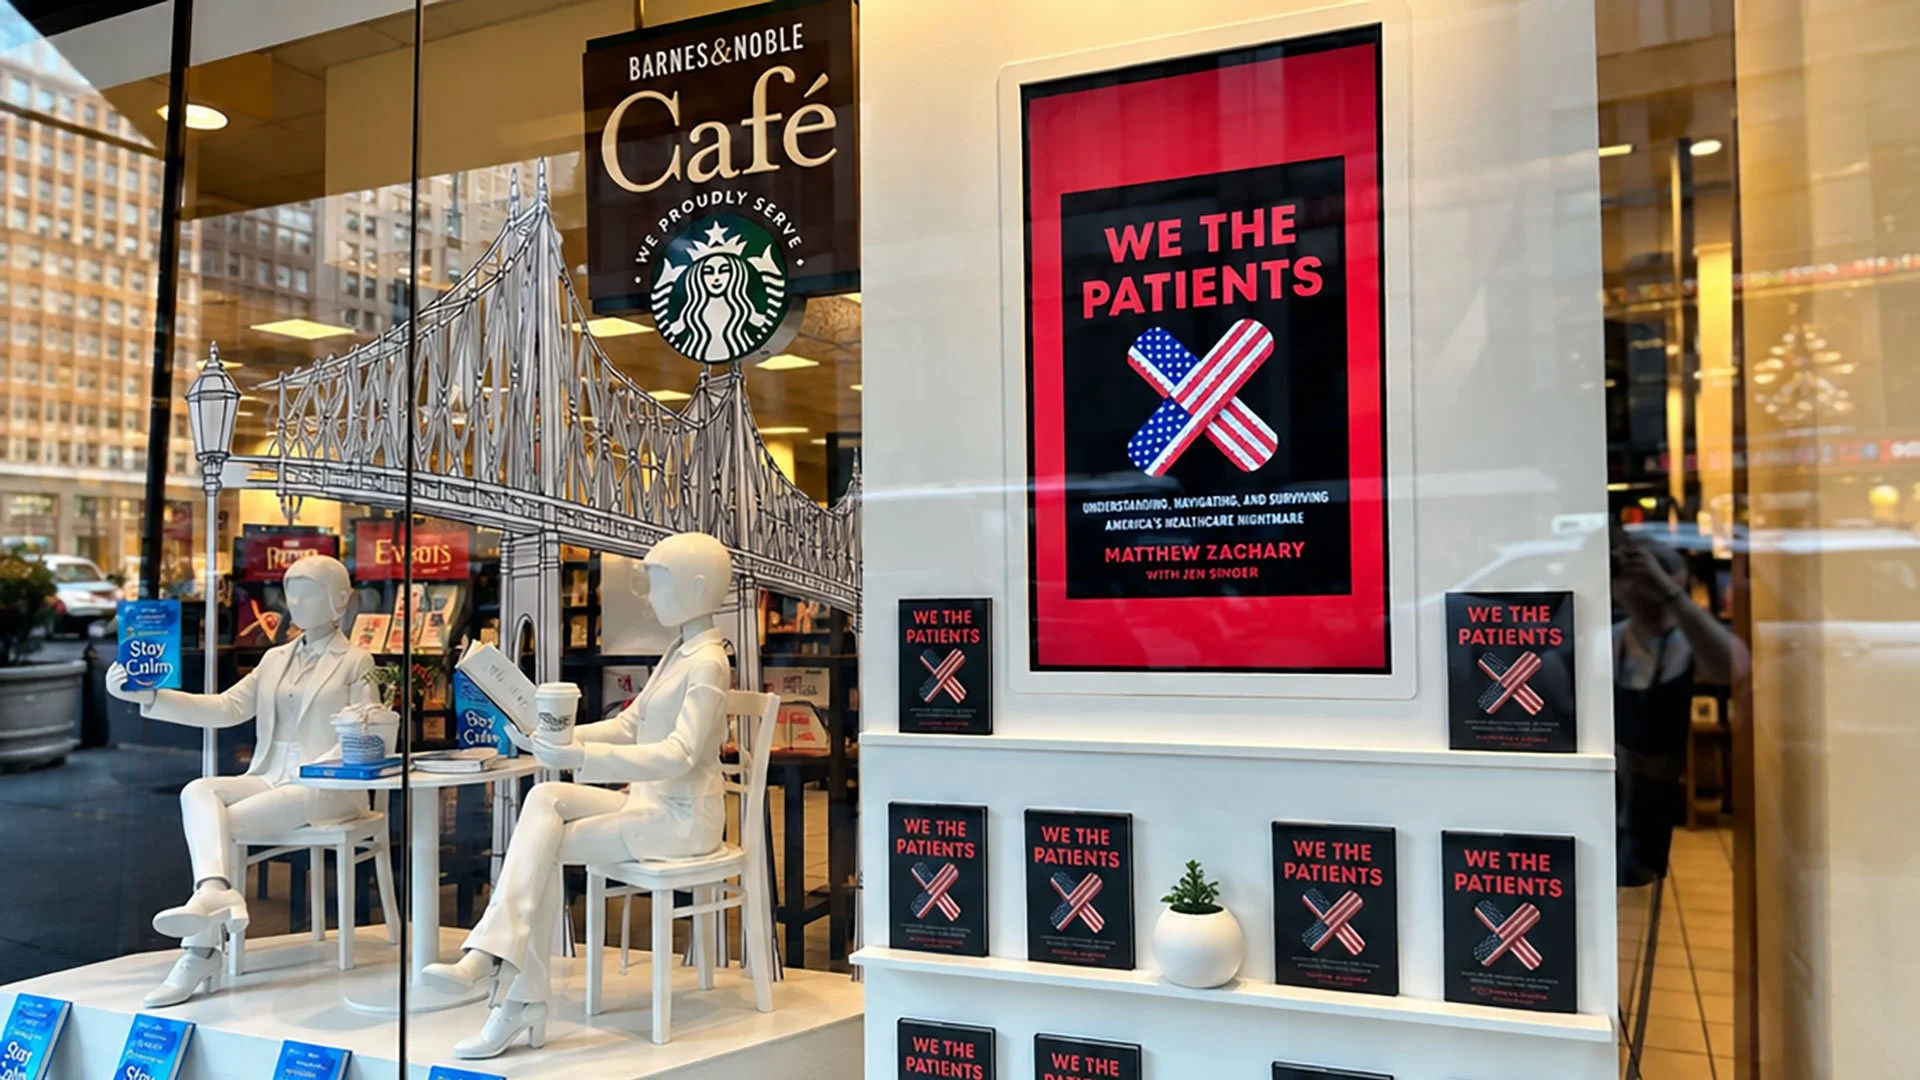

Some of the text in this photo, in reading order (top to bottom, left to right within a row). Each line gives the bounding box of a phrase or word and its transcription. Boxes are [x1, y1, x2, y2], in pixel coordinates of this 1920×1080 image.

[629, 23, 804, 81] BARNES&NOBLE
[601, 65, 838, 193] Café
[635, 190, 802, 264] WE PROUDLY SERVE
[1104, 204, 1296, 263] WE THE
[1083, 256, 1323, 319] PATIENTS
[1243, 493, 1267, 506] AND
[1105, 541, 1305, 563] MATTHEW ZACHARY
[1146, 569, 1179, 581] WITH
[1182, 568, 1206, 580] JEN
[913, 609, 973, 625] WE THE
[1467, 605, 1551, 623] WE THE
[906, 628, 981, 645] PATIENTS
[1458, 627, 1563, 647] PATIENTS
[903, 818, 967, 838] WE THE
[1040, 825, 1111, 846] WE THE
[895, 838, 976, 860] PATIENTS
[1033, 846, 1121, 869] PATIENTS
[1292, 839, 1373, 862] WE THE
[1464, 849, 1552, 873] WE THE
[1283, 861, 1384, 887] PATIENTS
[1454, 872, 1564, 898] PATIENTS
[912, 1036, 975, 1059] WE THE
[905, 1055, 983, 1080] PATIENTS
[1051, 1052, 1120, 1077] WE THE
